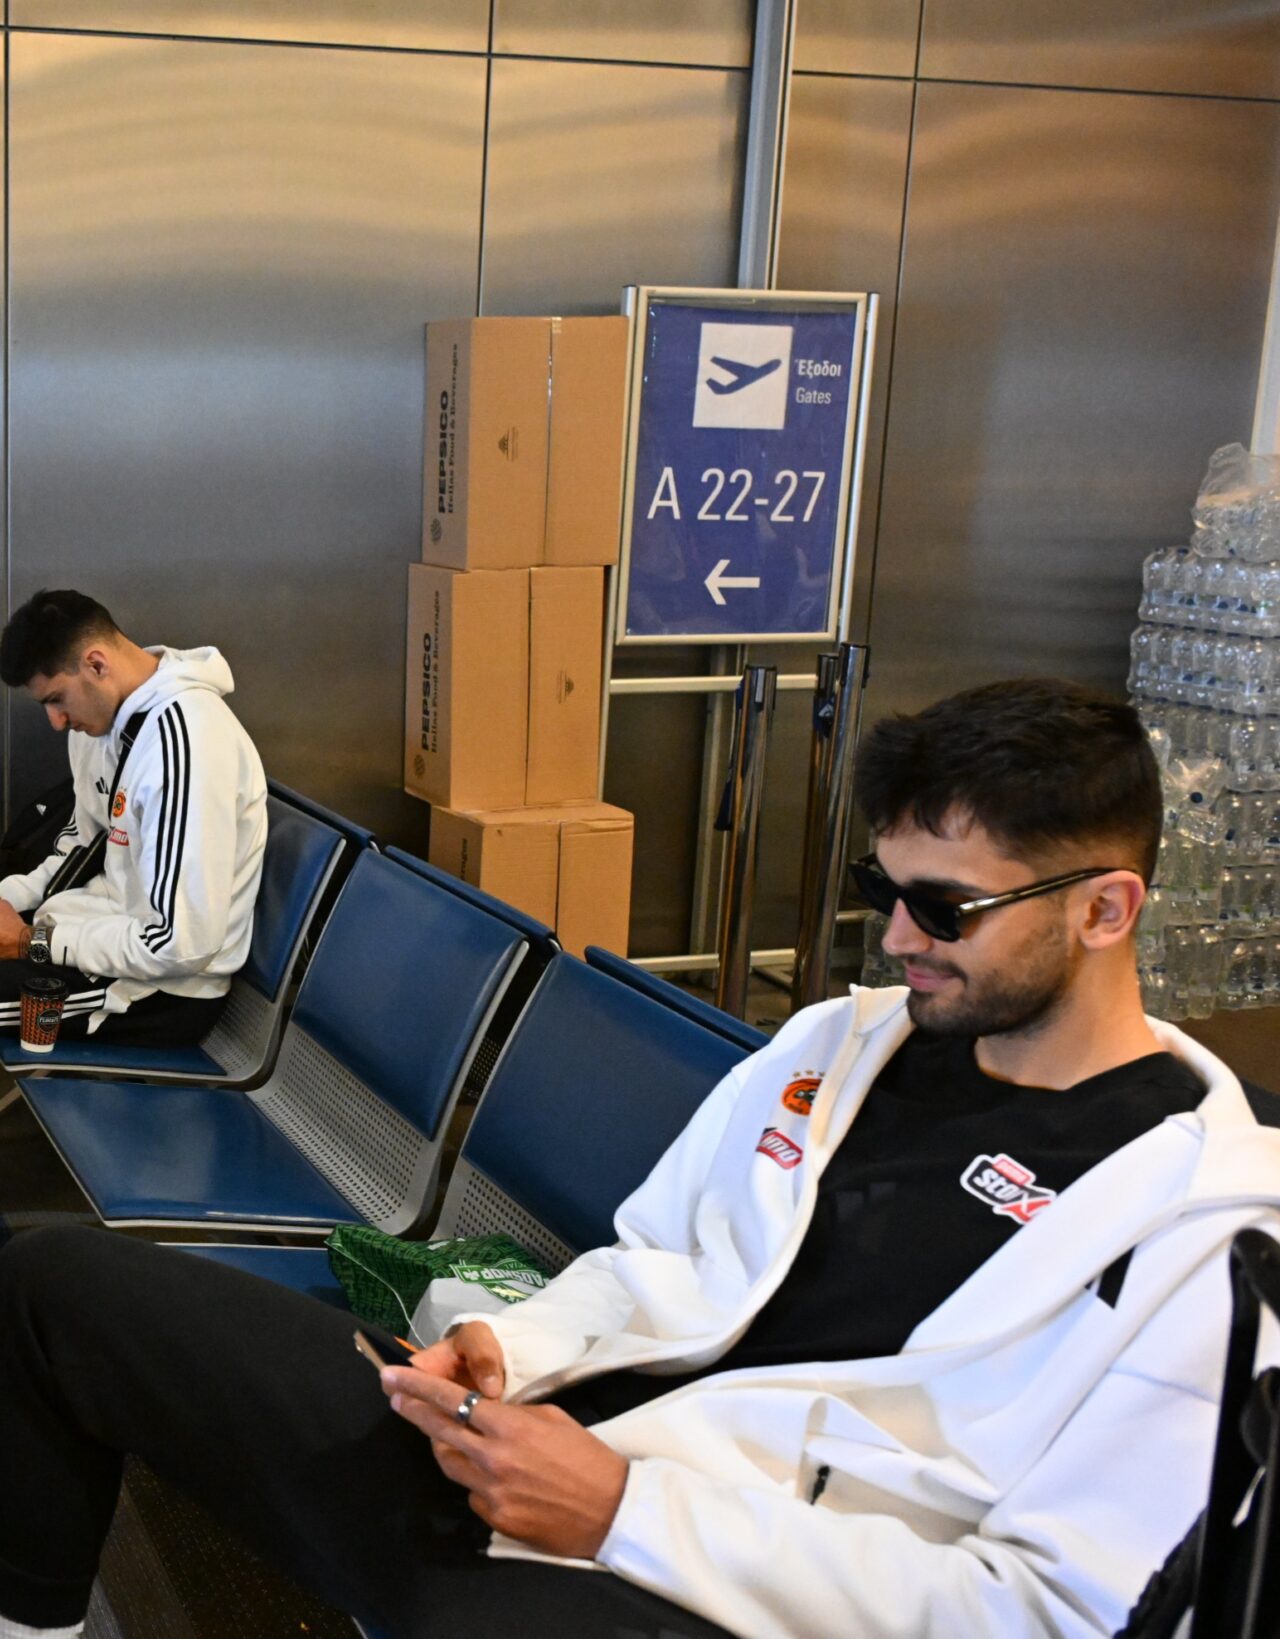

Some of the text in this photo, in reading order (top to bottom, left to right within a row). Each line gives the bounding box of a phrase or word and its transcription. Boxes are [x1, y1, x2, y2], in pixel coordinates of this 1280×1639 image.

[795, 359, 842, 379] Έξοδοι
[795, 388, 831, 404] Gates
[438, 390, 449, 513] PEPSICO
[448, 432, 456, 467] Food
[647, 467, 826, 522] A 22-27
[422, 633, 431, 751] PEPSICO
